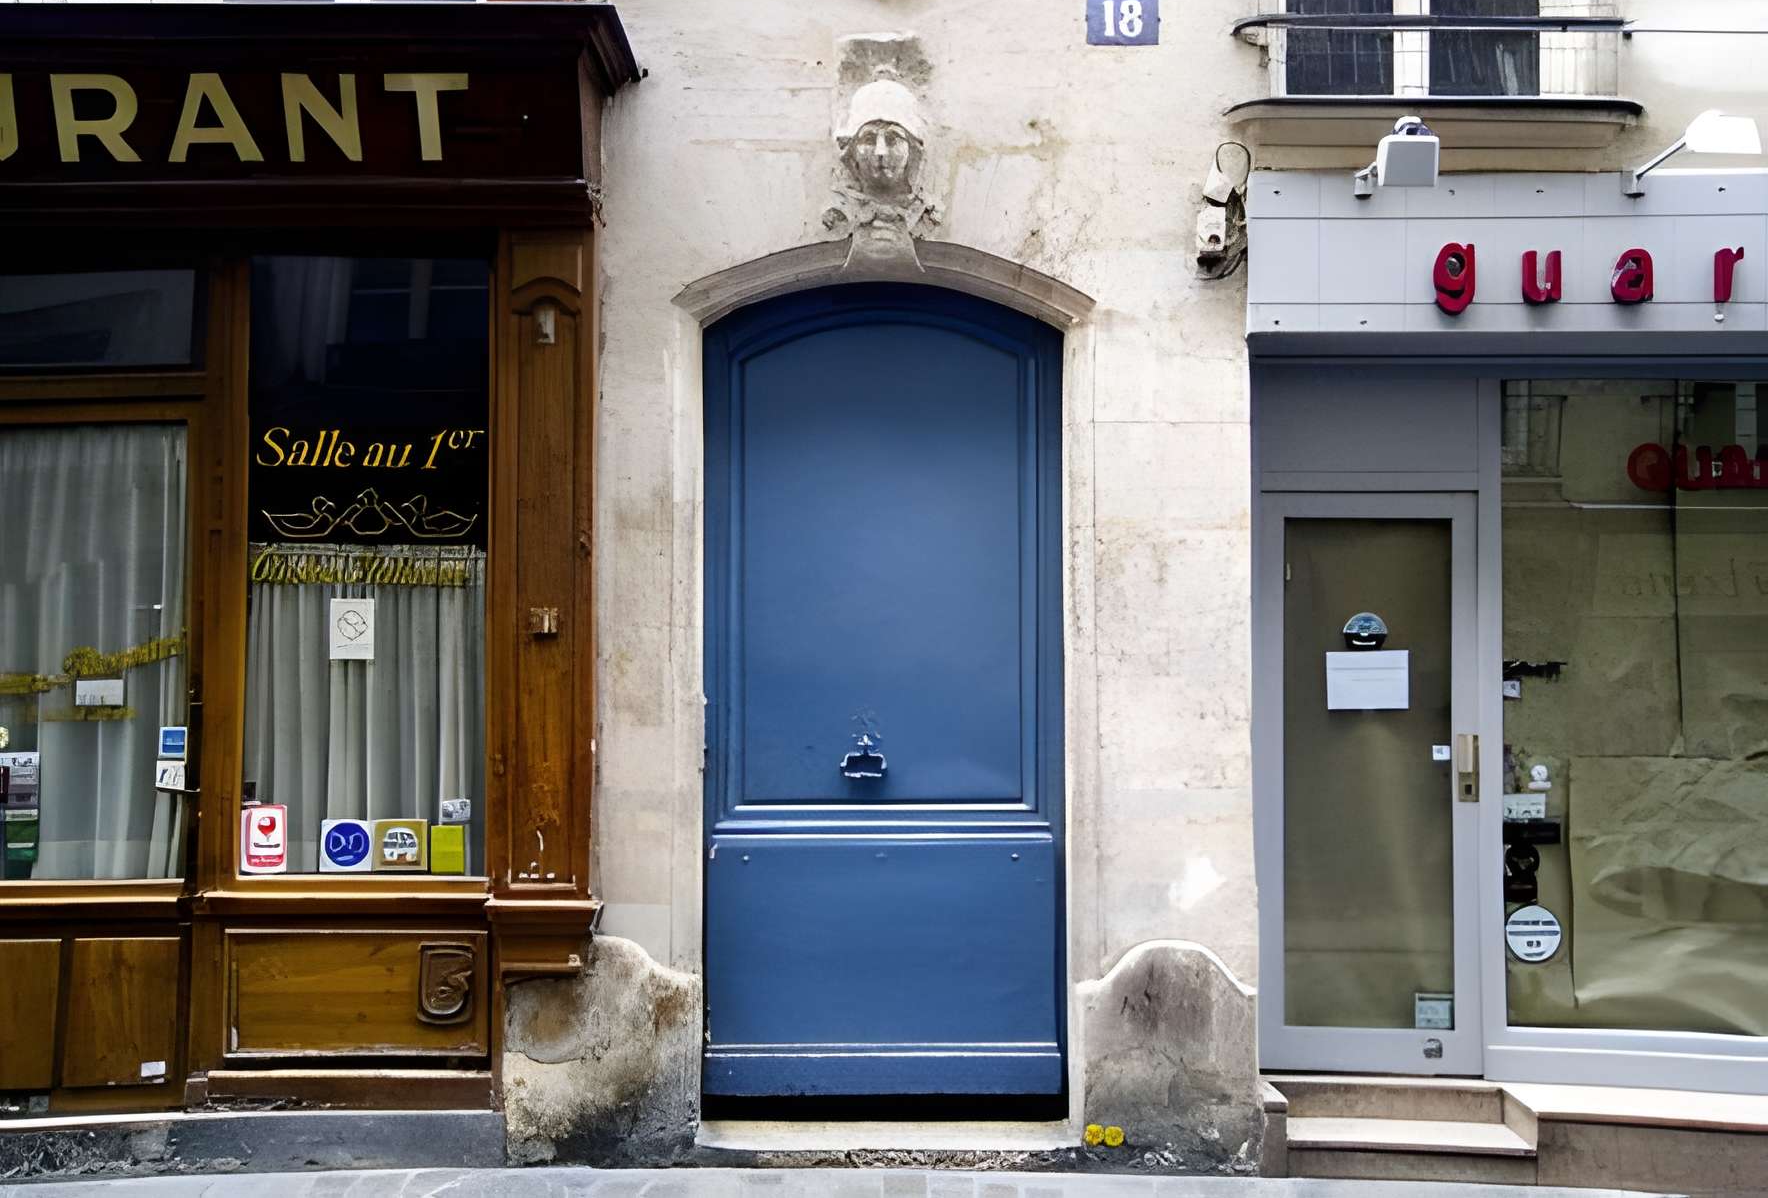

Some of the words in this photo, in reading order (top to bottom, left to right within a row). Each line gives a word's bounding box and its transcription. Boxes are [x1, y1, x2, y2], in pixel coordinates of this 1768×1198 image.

[1103, 0, 1143, 37] 18
[0, 72, 469, 162] RANT
[257, 427, 355, 468] Salle
[362, 443, 412, 468] au
